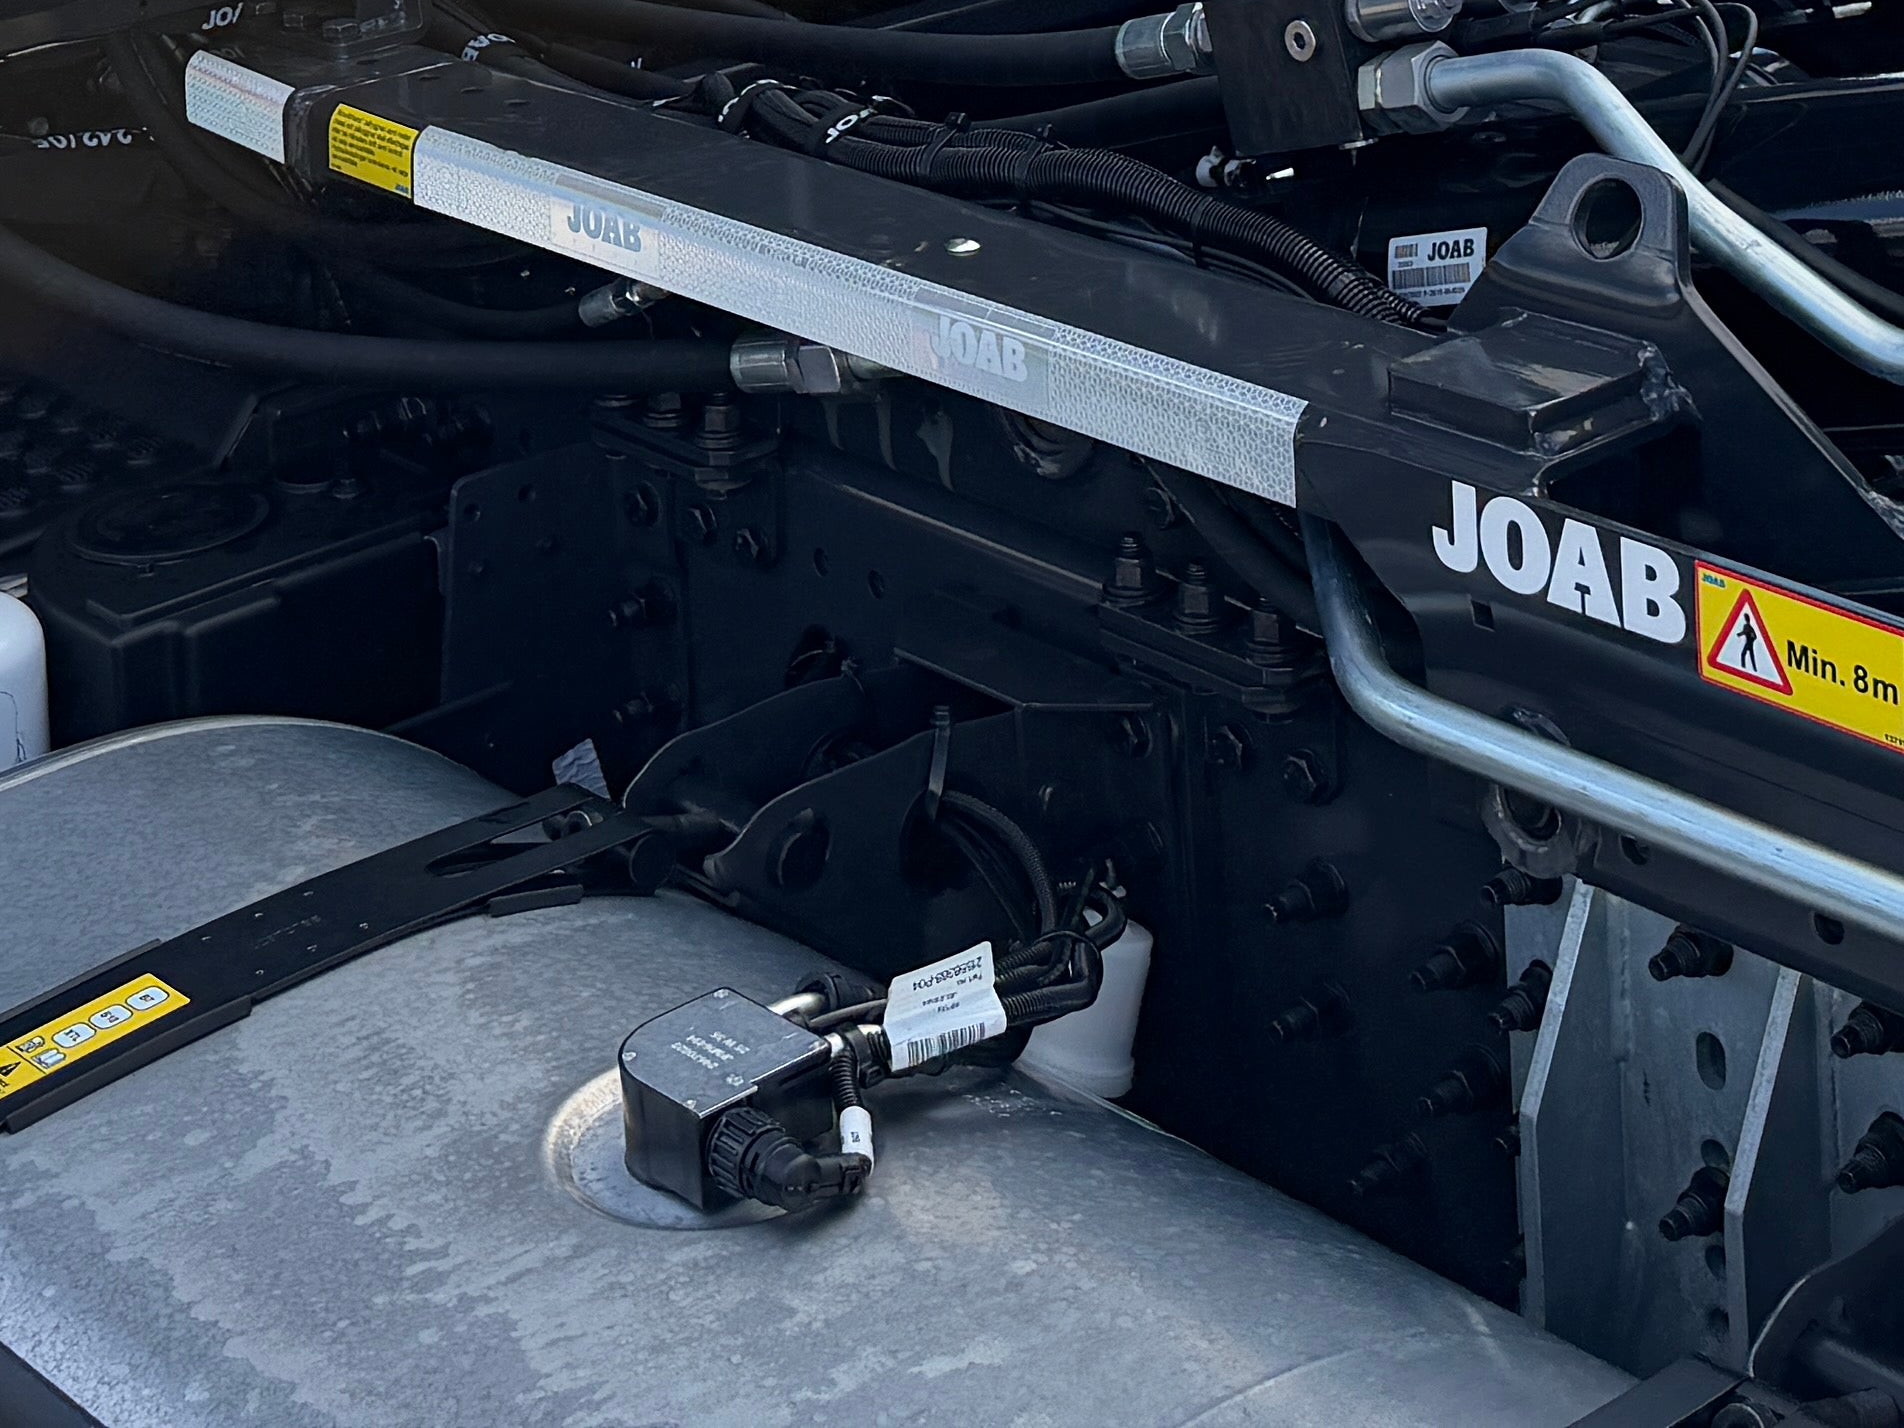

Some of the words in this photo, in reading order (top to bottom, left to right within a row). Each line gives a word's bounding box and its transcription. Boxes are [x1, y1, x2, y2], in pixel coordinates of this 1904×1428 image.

[567, 204, 642, 252] JOAB
[1427, 238, 1474, 261] JOAB
[929, 315, 1028, 382] JOAB
[1431, 480, 1687, 644] JOAB
[1786, 639, 1846, 687] Min.
